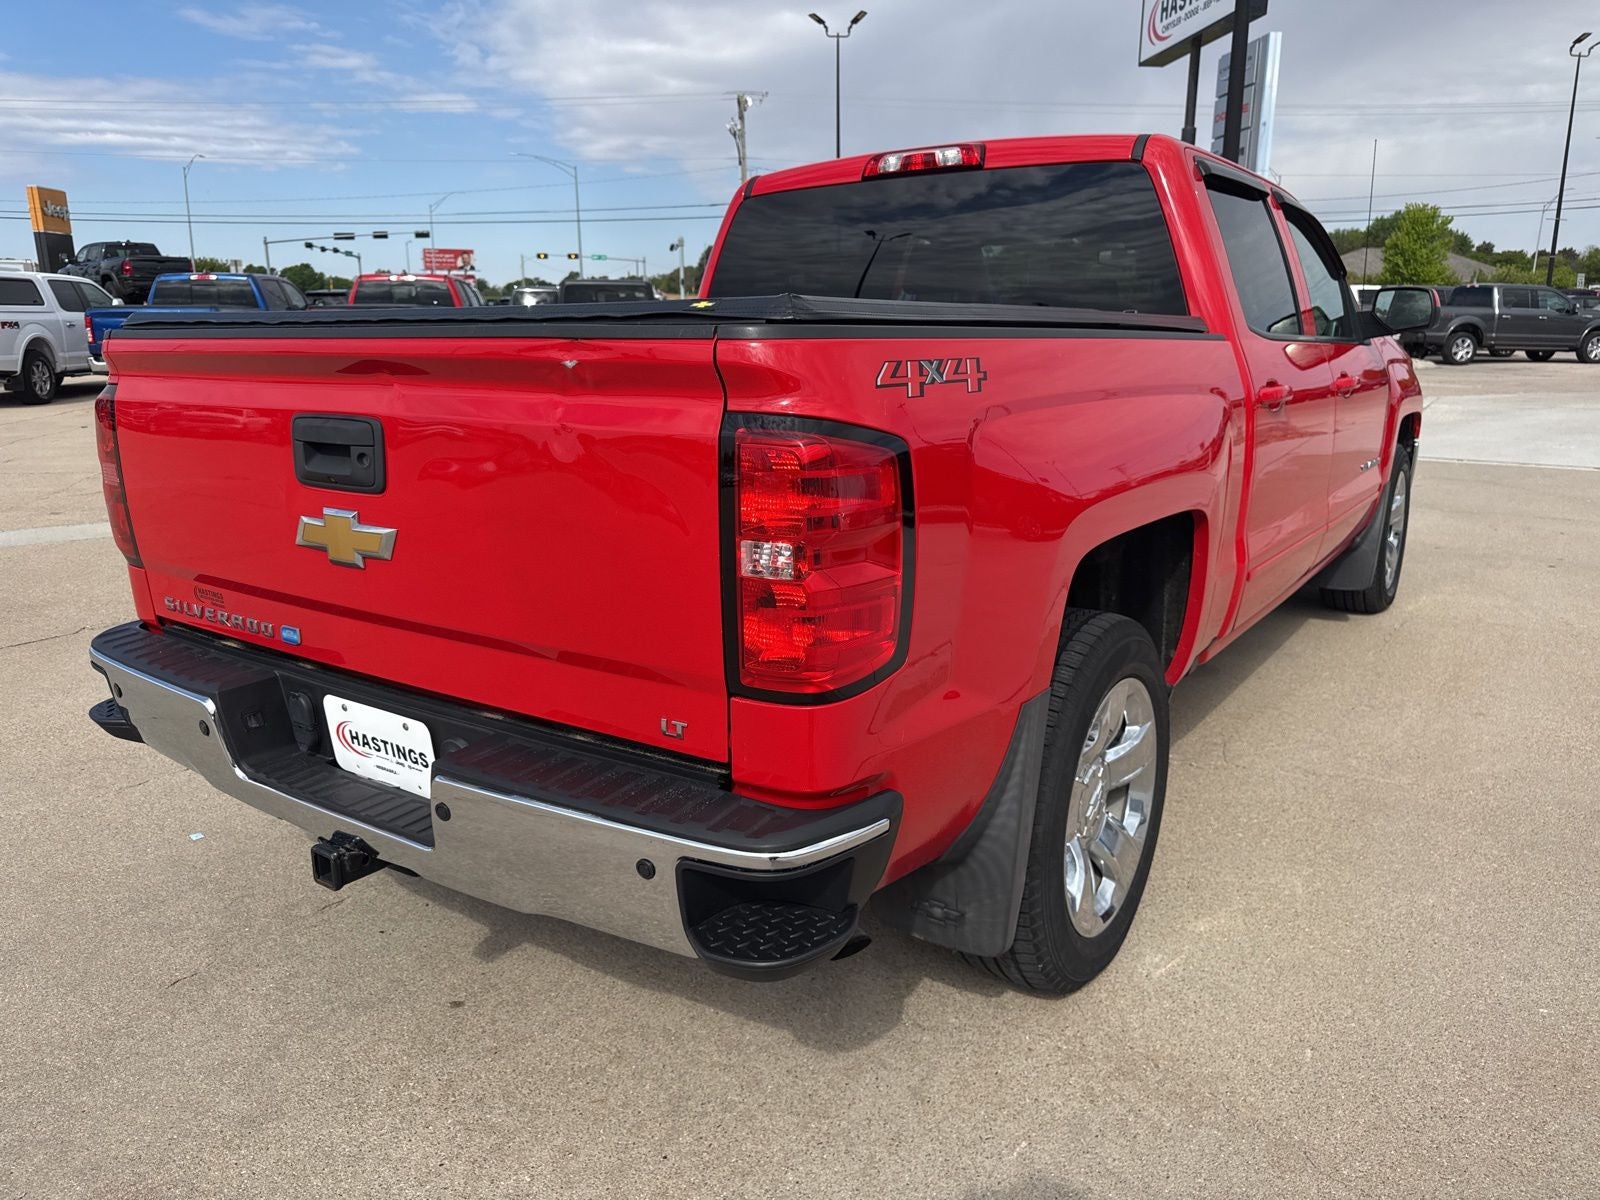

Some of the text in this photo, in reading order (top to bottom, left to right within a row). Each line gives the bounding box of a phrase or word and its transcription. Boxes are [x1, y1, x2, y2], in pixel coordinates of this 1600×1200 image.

[43, 200, 71, 221] Jeep
[164, 596, 274, 637] SILVERADO
[660, 718, 688, 739] LT
[349, 729, 429, 768] HASTINGS
